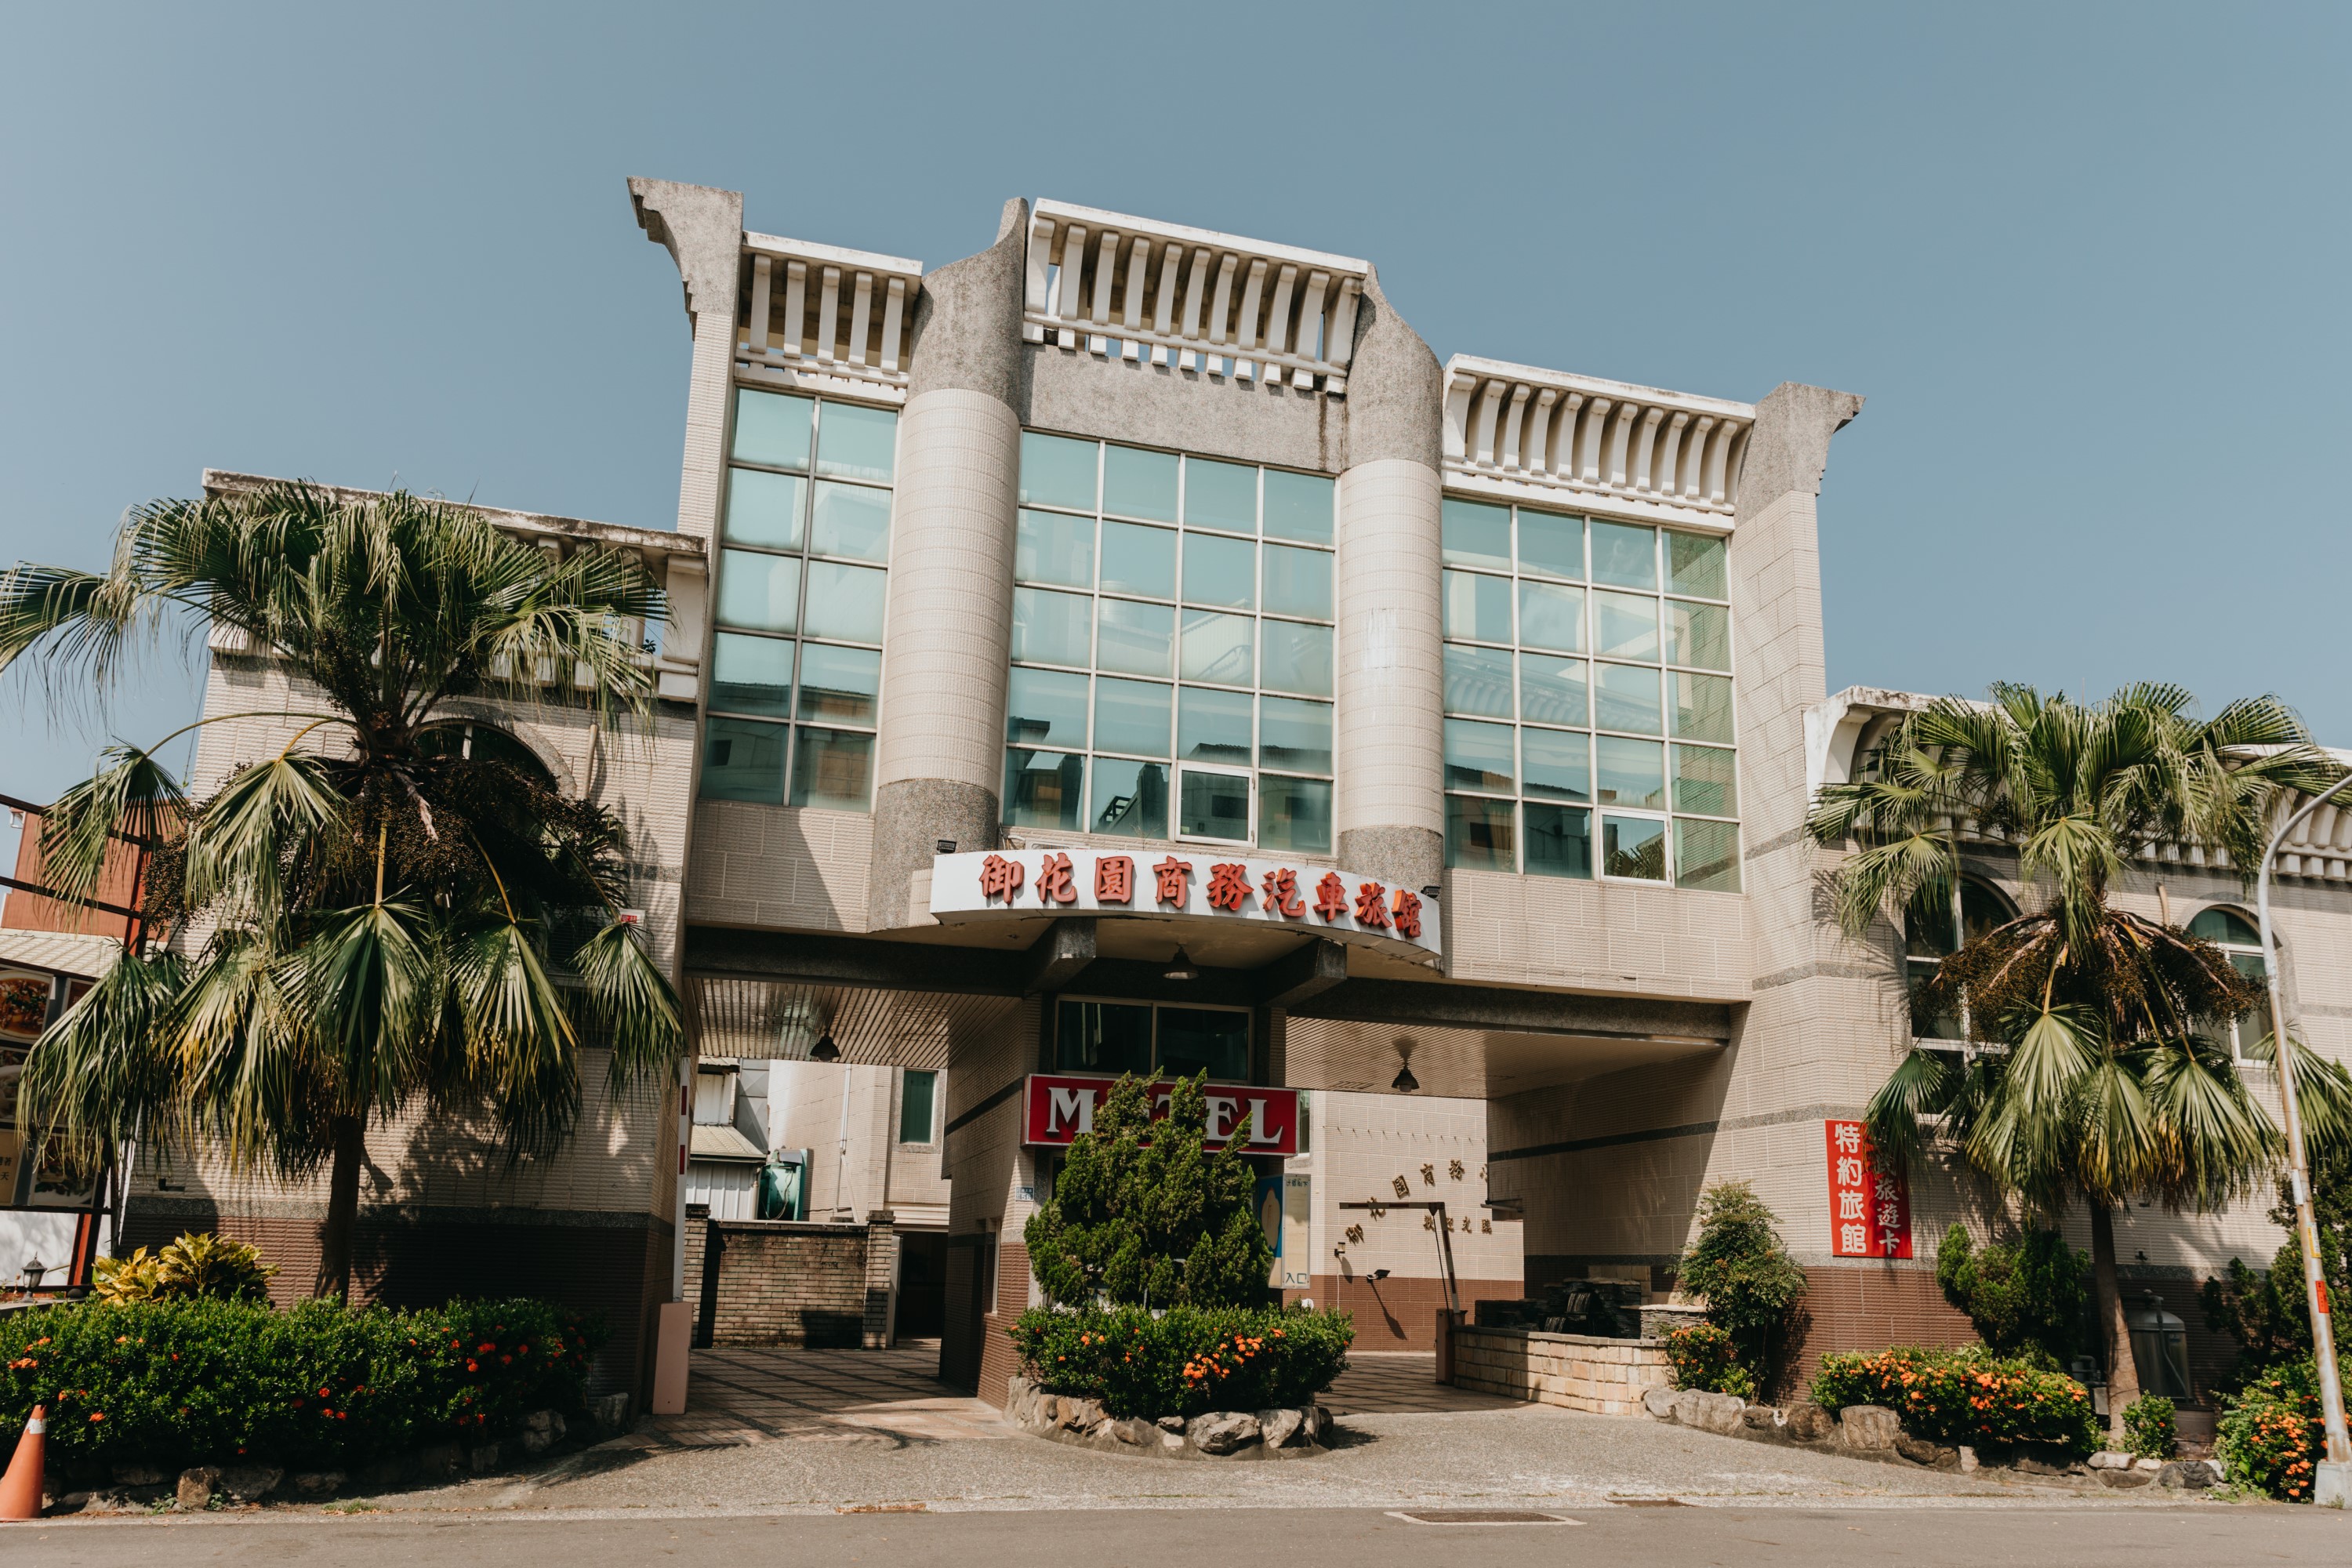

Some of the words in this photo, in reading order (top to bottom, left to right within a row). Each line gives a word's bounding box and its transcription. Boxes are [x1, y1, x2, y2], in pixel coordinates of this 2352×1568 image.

[978, 852, 1422, 938] 御花園商務汽車旅館
[1835, 1123, 1867, 1254] 特約旅館
[1286, 1272, 1308, 1284] 入口
